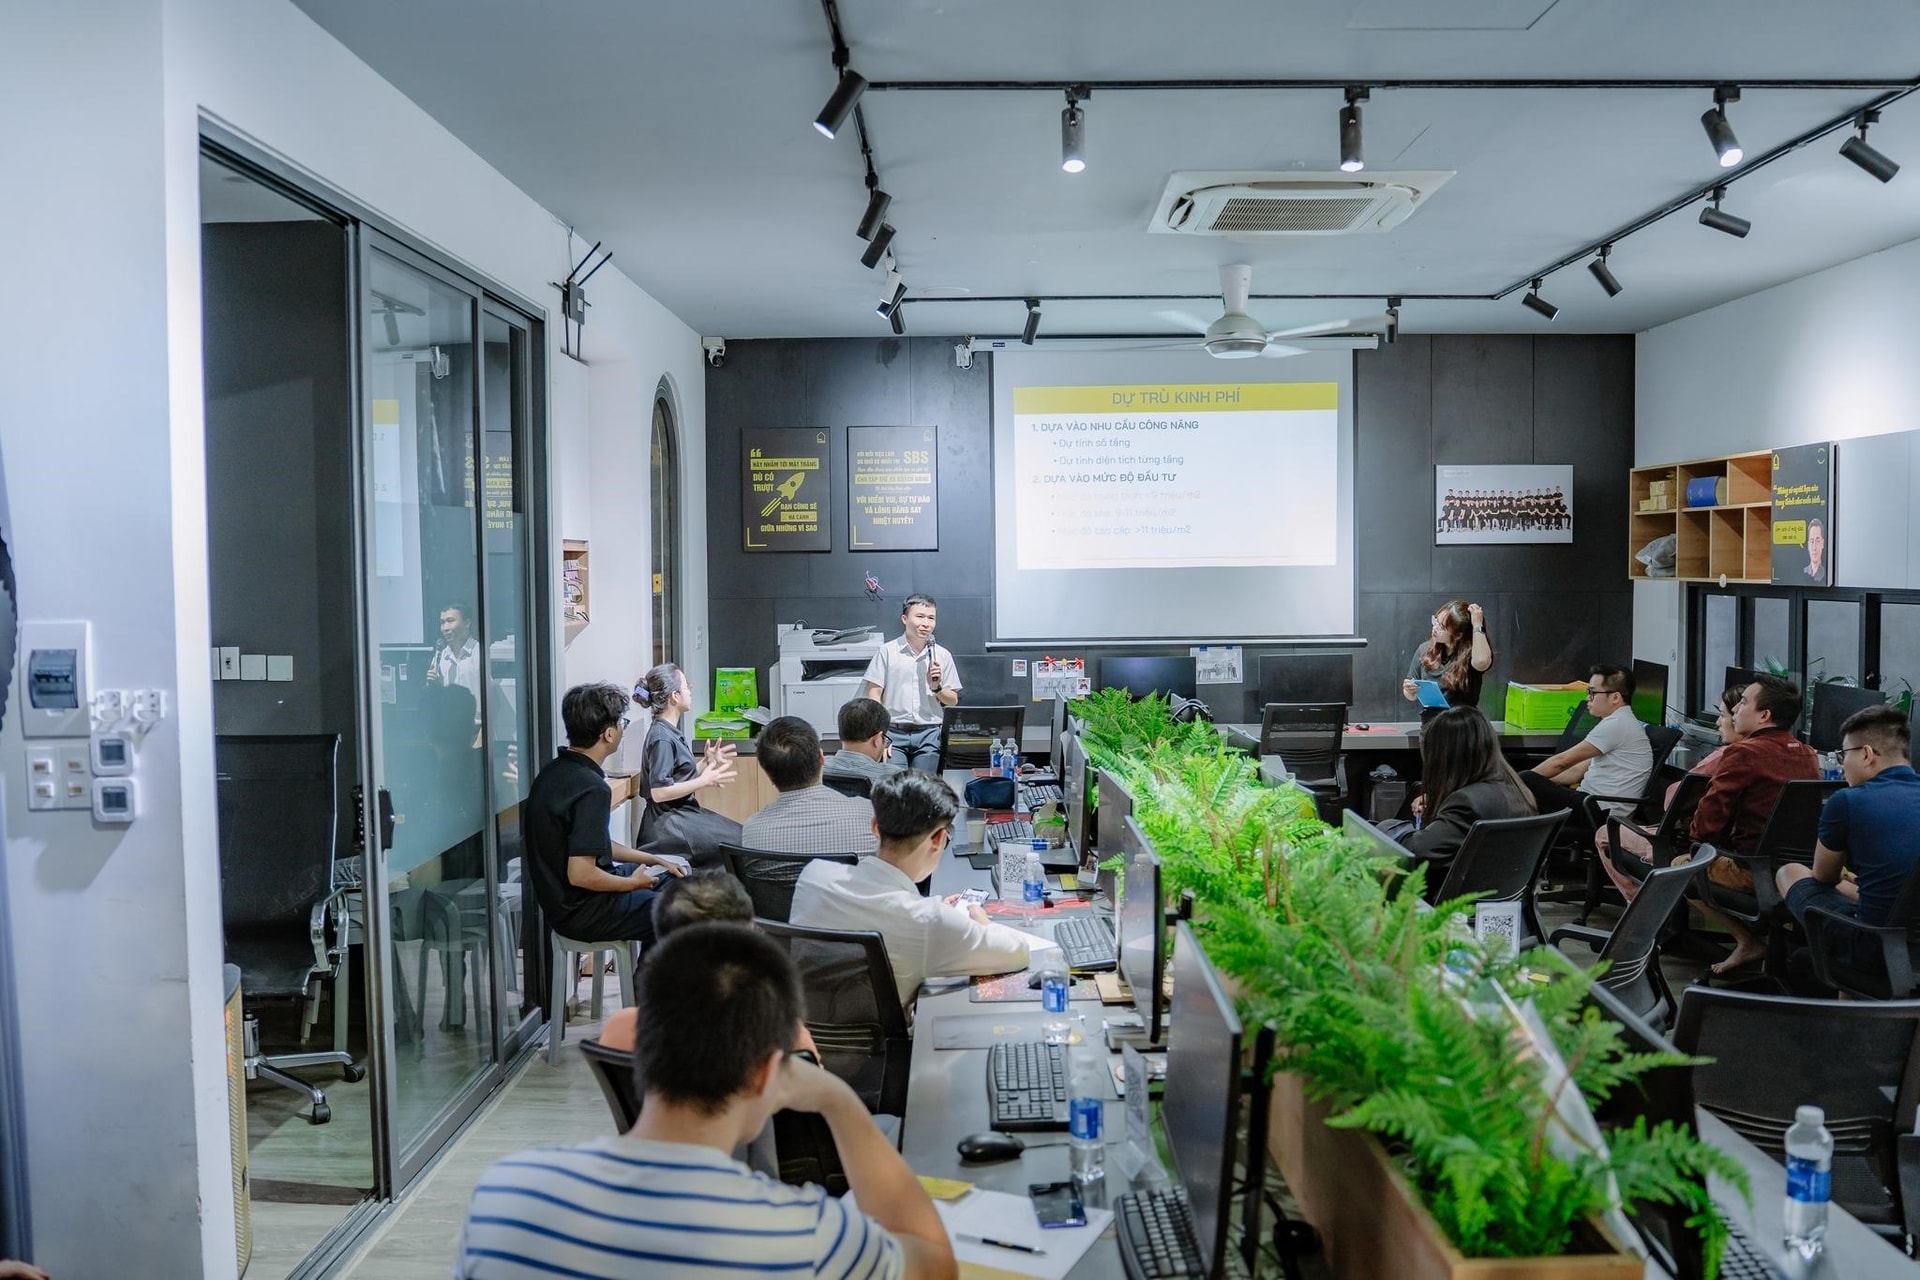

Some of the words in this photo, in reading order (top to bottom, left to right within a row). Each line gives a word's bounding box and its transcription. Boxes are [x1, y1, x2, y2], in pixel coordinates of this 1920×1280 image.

[1112, 391, 1136, 408] DỰ
[1140, 387, 1169, 404] TRÙ
[1175, 391, 1210, 404] KINH
[1215, 386, 1240, 403] PHÍ
[1041, 423, 1063, 433] DỰA
[1066, 420, 1087, 432] VÀO
[1090, 422, 1112, 431] NHU
[1139, 419, 1168, 430] CÔNG
[1170, 419, 1199, 430] NĂNG
[903, 450, 929, 465] SBS
[1044, 475, 1066, 485] DỰA
[1069, 473, 1090, 483] VÀO
[1093, 471, 1117, 483] MỨC
[1120, 471, 1135, 484] ĐỘ
[1161, 473, 1177, 482] TƯ
